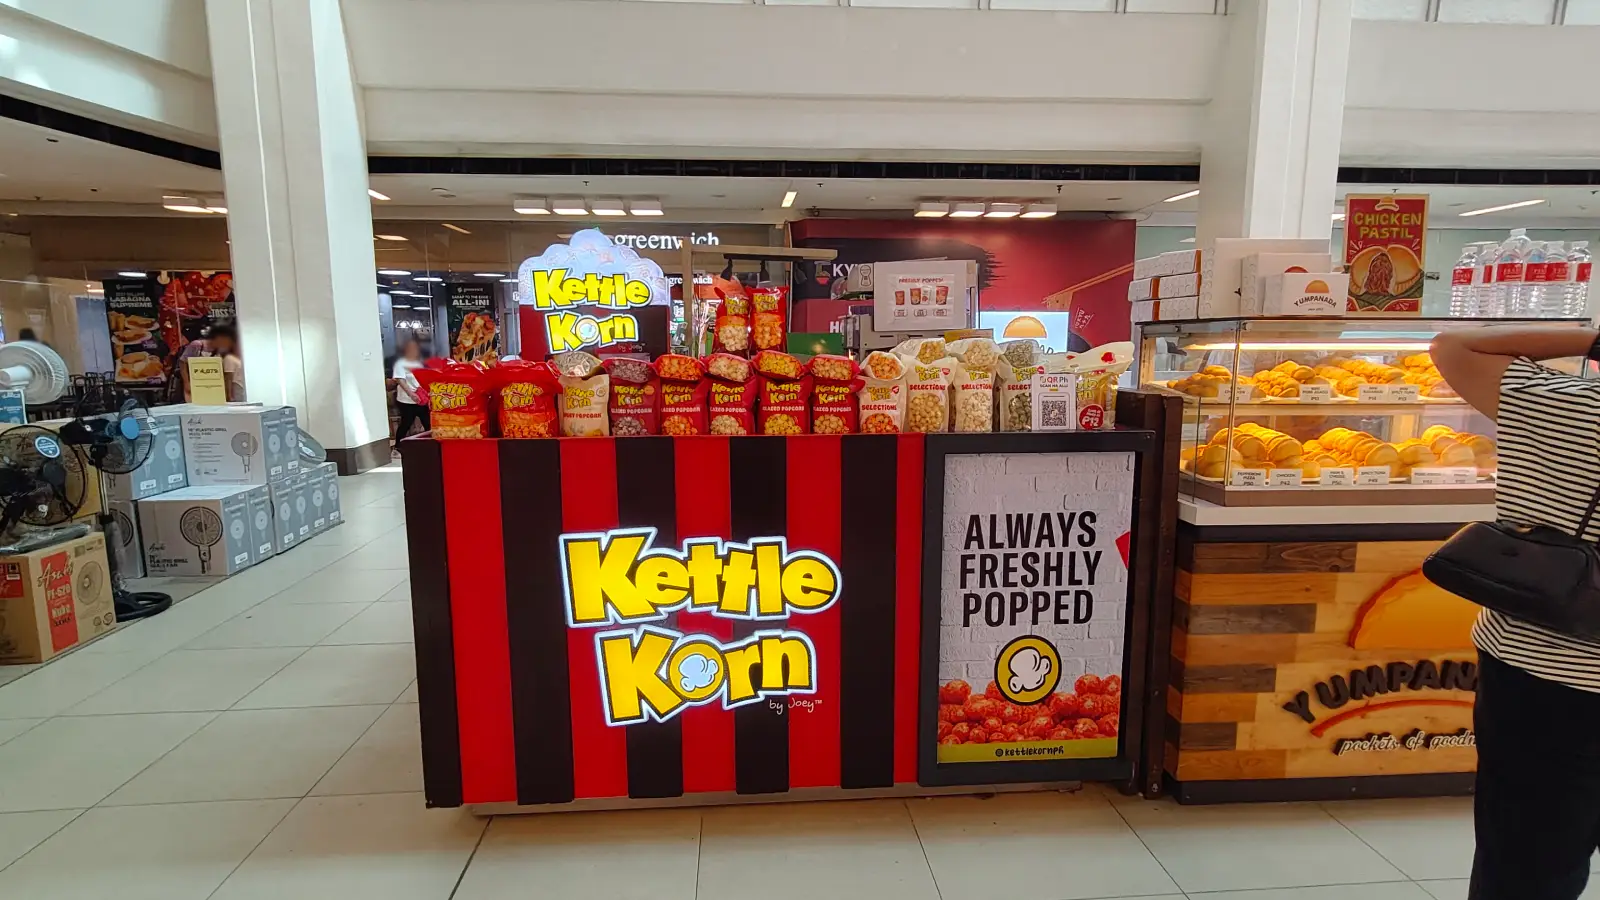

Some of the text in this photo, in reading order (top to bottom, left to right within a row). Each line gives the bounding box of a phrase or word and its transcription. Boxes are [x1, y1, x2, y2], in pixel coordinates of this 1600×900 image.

[1354, 212, 1422, 226] CHICKEN
[1360, 227, 1414, 239] PASTIL
[532, 267, 653, 309] Kettle
[669, 273, 714, 288] grewich
[1293, 295, 1337, 308] YUMPANADA
[546, 312, 638, 352] Korn
[429, 382, 473, 396] Kettle
[430, 395, 468, 412] Korn
[503, 395, 536, 411] Korn
[566, 397, 592, 410] Korn
[618, 395, 643, 406] Korn
[664, 393, 692, 406] Korn
[714, 393, 742, 405] Korn
[769, 391, 798, 404] Korn
[818, 393, 847, 405] Korn
[963, 510, 1098, 550] ALWAYS
[562, 530, 840, 624] Kettle
[959, 551, 1103, 590] FRESHLY
[962, 589, 1094, 628] POPPED
[598, 627, 814, 723] Korn
[1282, 660, 1478, 723] YUMPAN
[769, 699, 784, 715] by
[1338, 730, 1476, 757] pockets of goodn
[994, 746, 1065, 758] @kettlekornph
